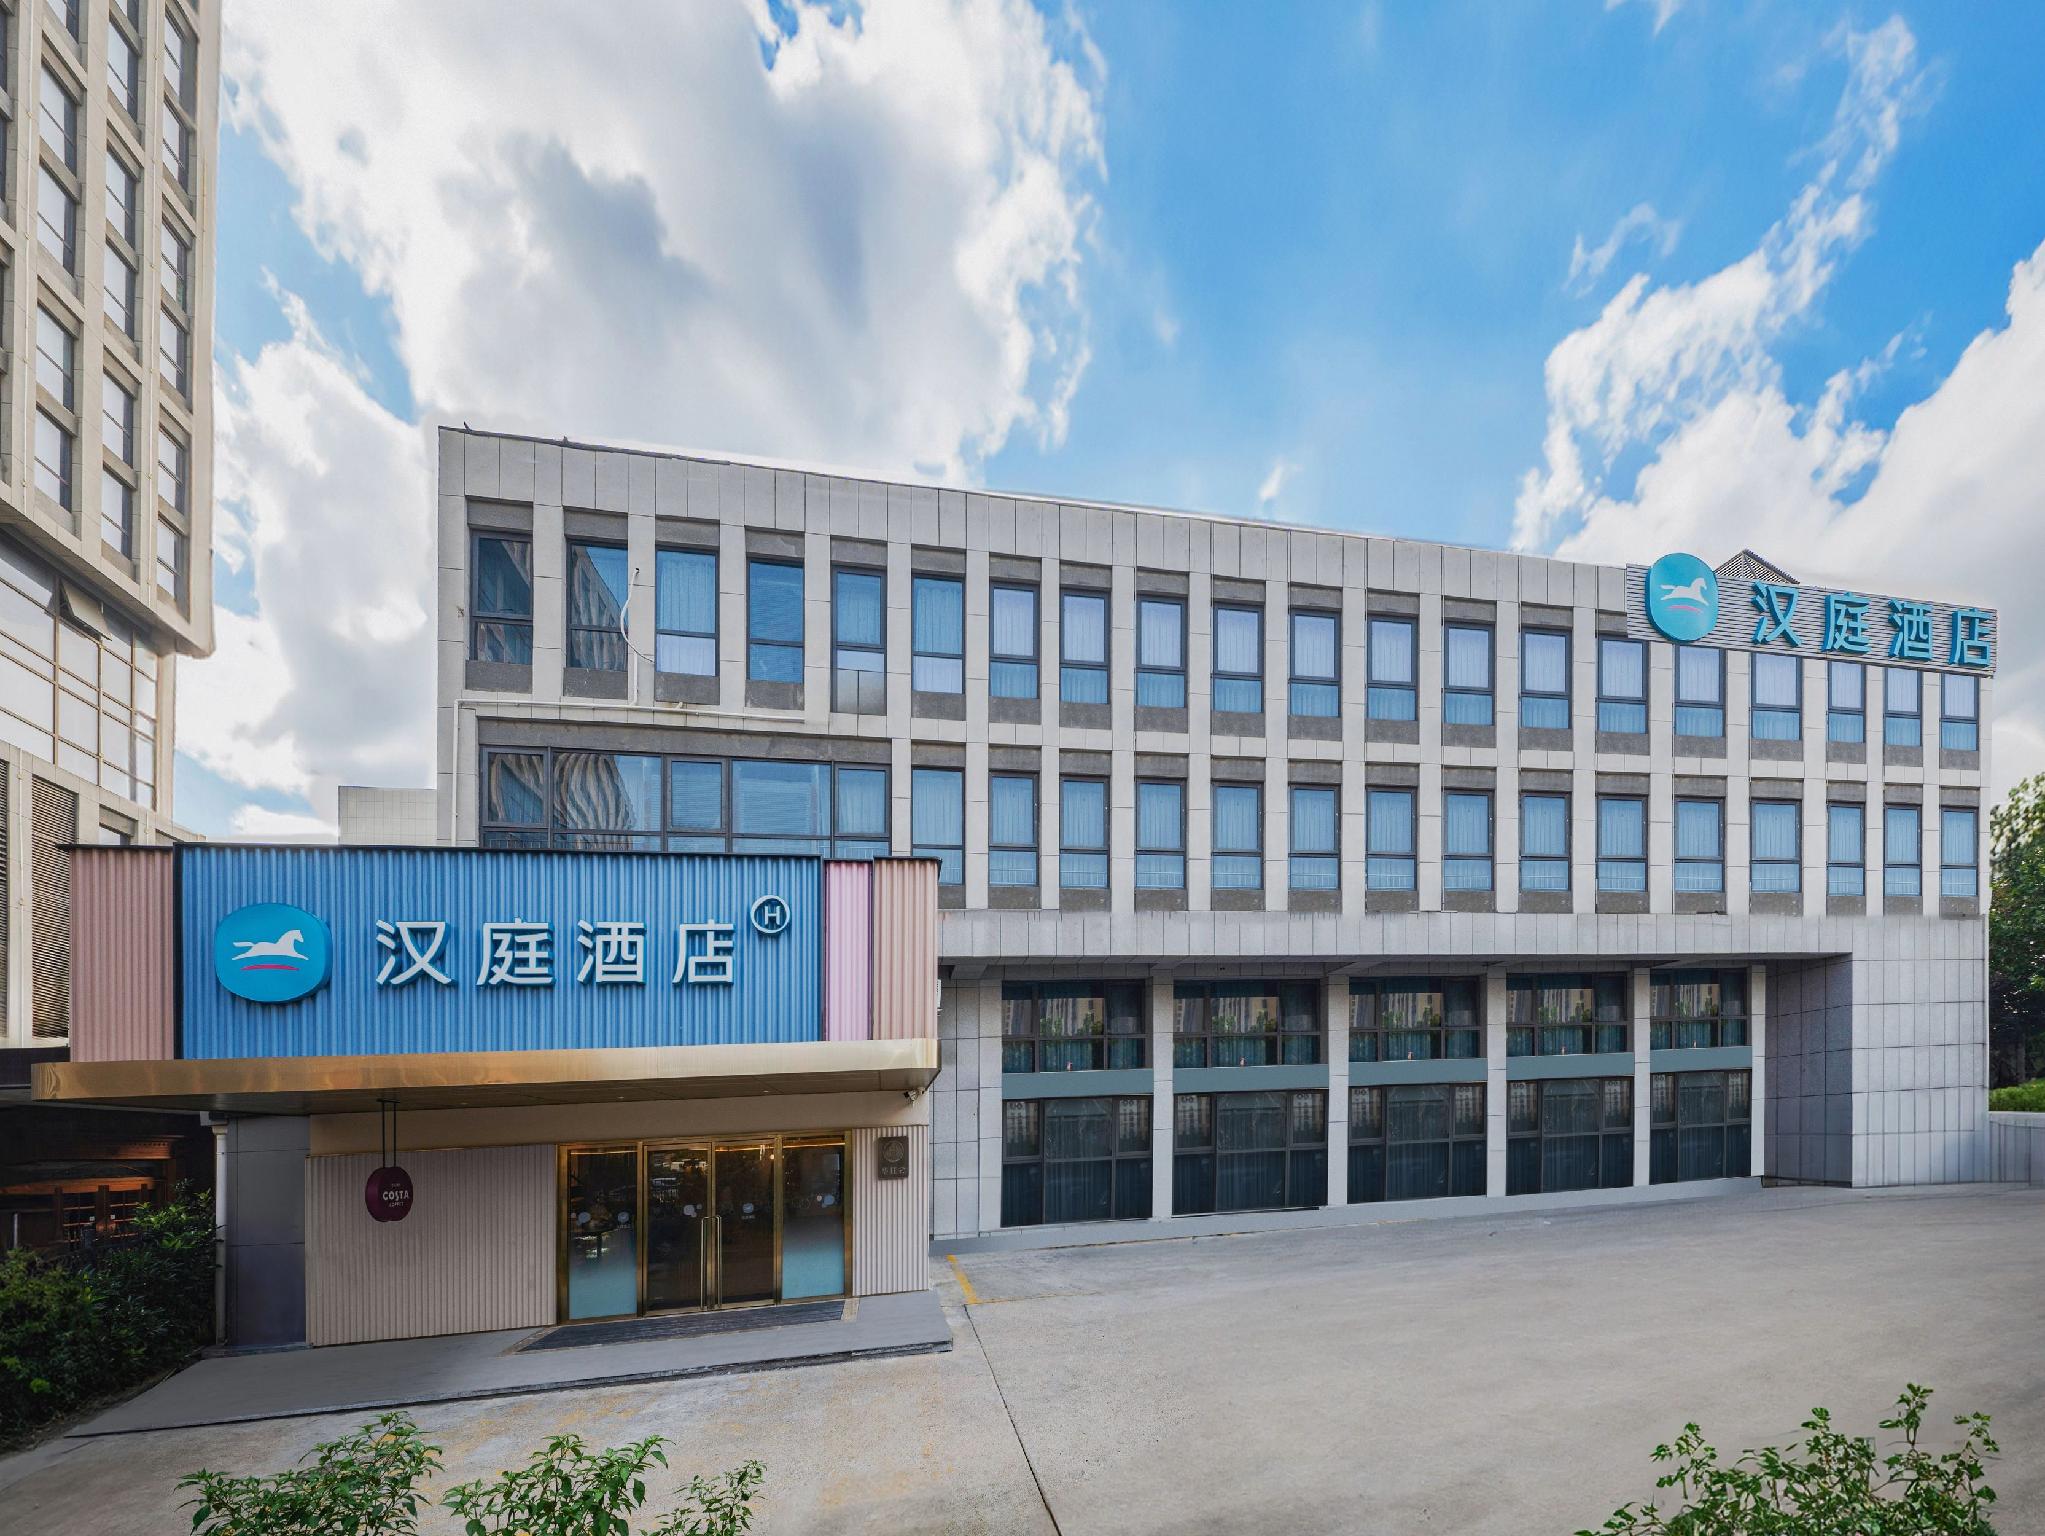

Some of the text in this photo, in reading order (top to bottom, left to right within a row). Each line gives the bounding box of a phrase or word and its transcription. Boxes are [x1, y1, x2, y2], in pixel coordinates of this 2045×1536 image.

[1752, 580, 1992, 668] 汉庭酒店
[375, 917, 736, 986] 汉庭酒店
[382, 1190, 409, 1201] COSTA
